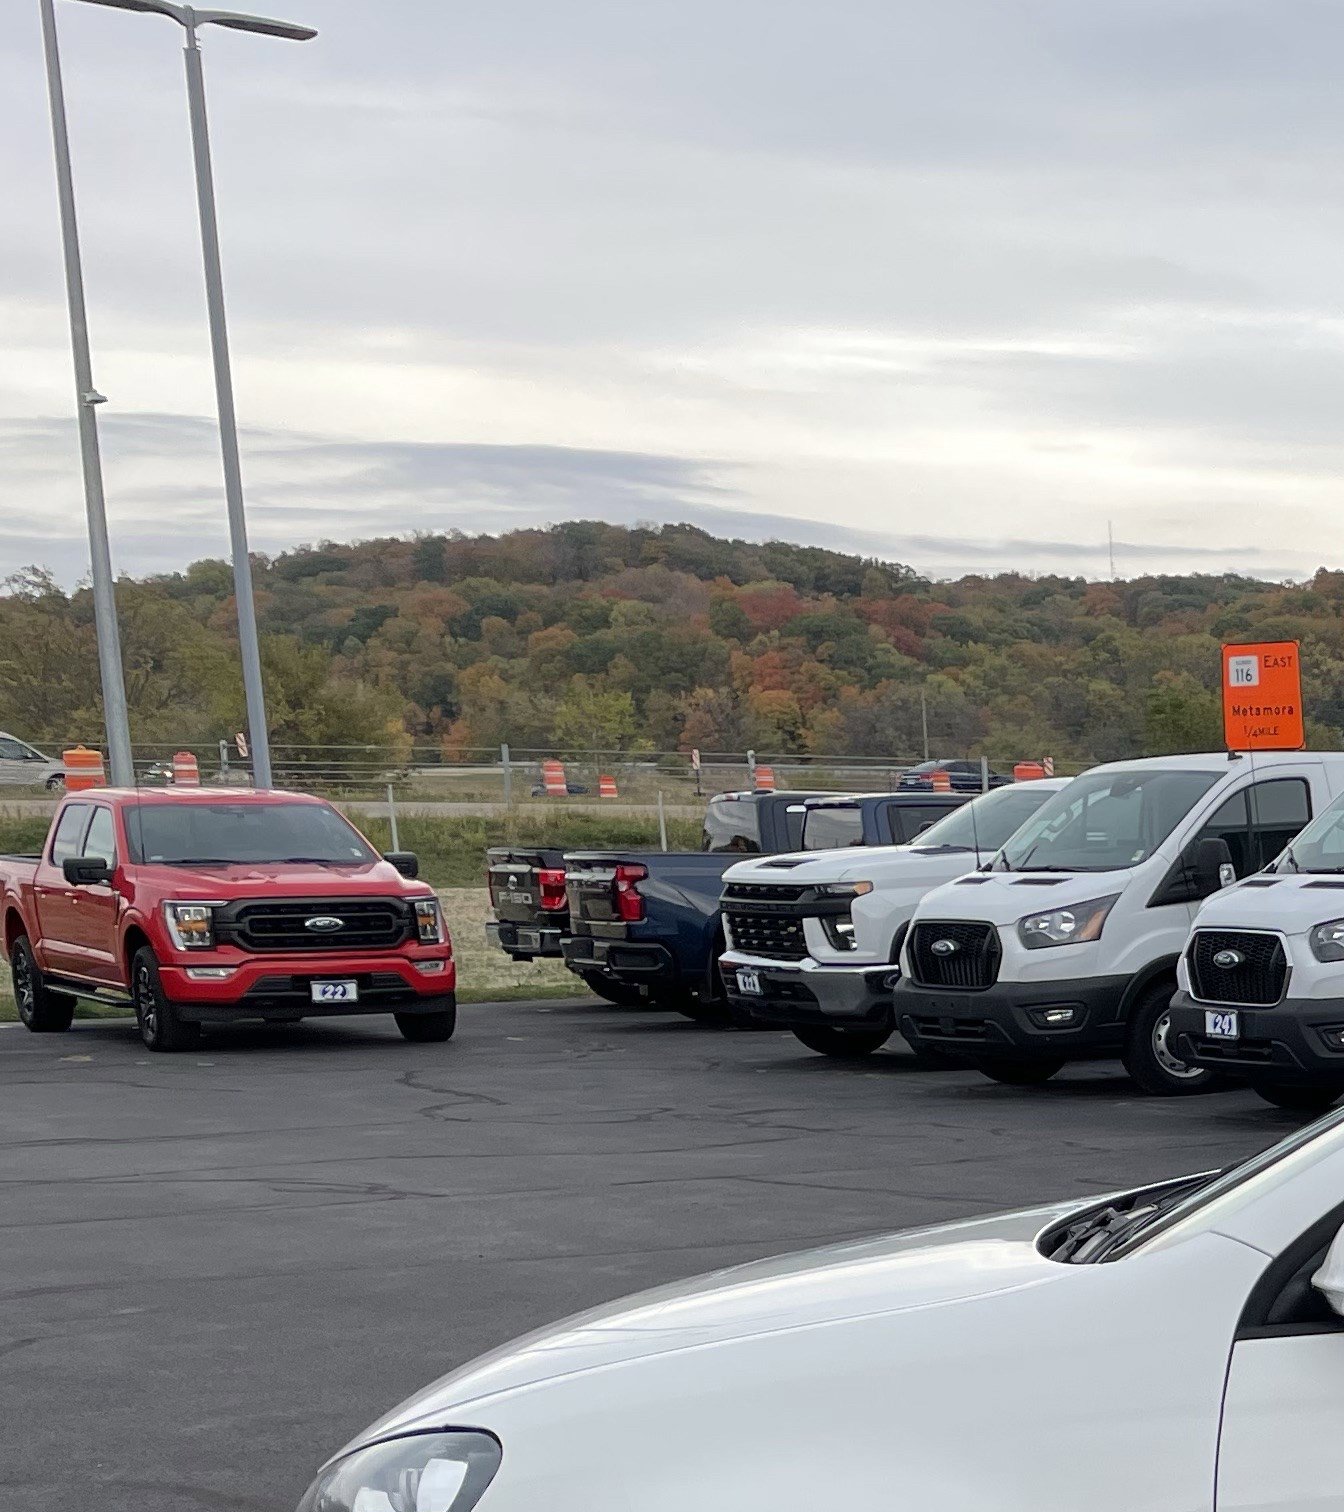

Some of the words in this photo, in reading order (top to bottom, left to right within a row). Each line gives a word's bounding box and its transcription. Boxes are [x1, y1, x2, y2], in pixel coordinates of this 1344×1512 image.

[1264, 655, 1292, 668] EAST
[1235, 668, 1252, 682] 116
[1231, 705, 1294, 716] Metamora
[324, 984, 345, 999] 22
[1213, 1014, 1231, 1035] 24
